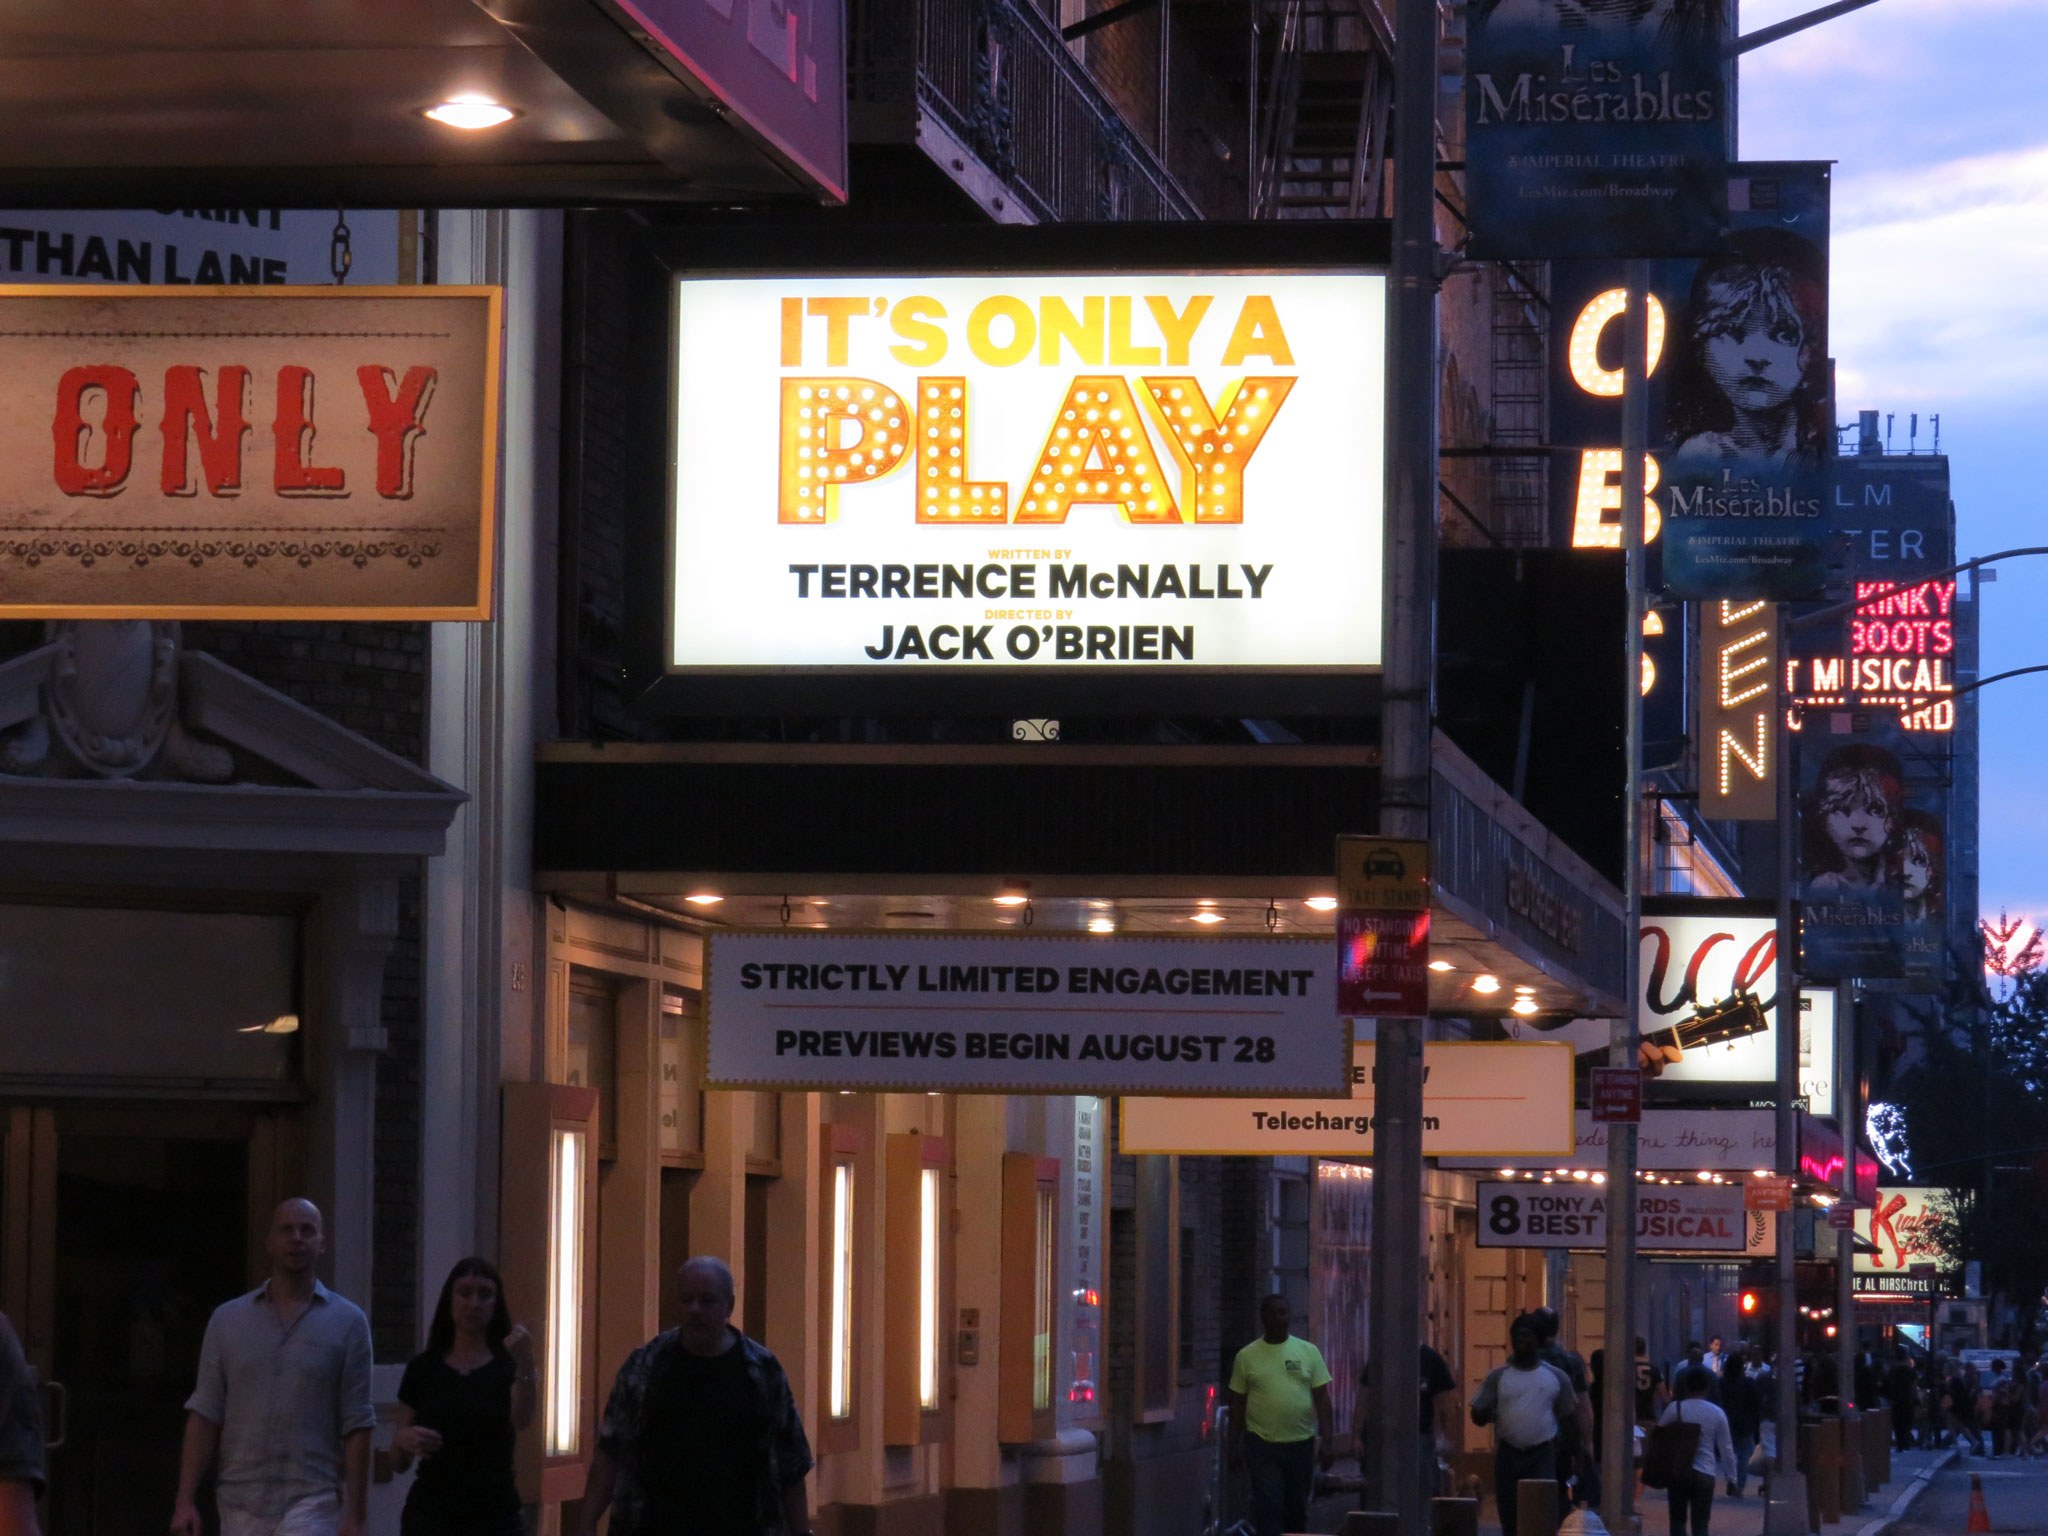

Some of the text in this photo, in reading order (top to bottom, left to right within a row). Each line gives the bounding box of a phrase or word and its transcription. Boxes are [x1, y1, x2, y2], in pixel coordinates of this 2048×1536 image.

[1561, 44, 1622, 84] Les
[1474, 71, 1715, 125] Misérables
[1523, 154, 1688, 169] IMPERIAL THEATRE
[1519, 183, 1678, 200] LesMiz.com/Broadway
[164, 244, 288, 285] LANE
[781, 295, 1296, 367] IT'S ONLY A
[51, 363, 441, 501] ONLY
[778, 375, 1299, 525] PLAY
[1721, 468, 1760, 493] Les
[1669, 484, 1821, 518] Misérables
[988, 549, 1072, 560] WRITTEN BY
[788, 563, 1274, 599] TERRENCE McNALLY
[985, 609, 1073, 620] DIRECTED BY
[1855, 581, 1956, 616] KINKY
[864, 624, 1195, 661] JACK O'BRIEN
[1343, 917, 1361, 934] NO
[740, 962, 1315, 996] STRICTLY LIMITED ENGAGEMENT
[775, 1029, 1277, 1064] PREVIEWS BEGIN AUGUST 28
[1253, 1111, 1440, 1134] Telechargm
[1674, 1130, 1737, 1159] thing
[1489, 1195, 1521, 1235] 8
[1526, 1196, 1585, 1213] TONY
[1589, 1197, 1681, 1214] ARDS
[1526, 1214, 1734, 1238] BEST USICAL
[1864, 1276, 1877, 1292] AL
